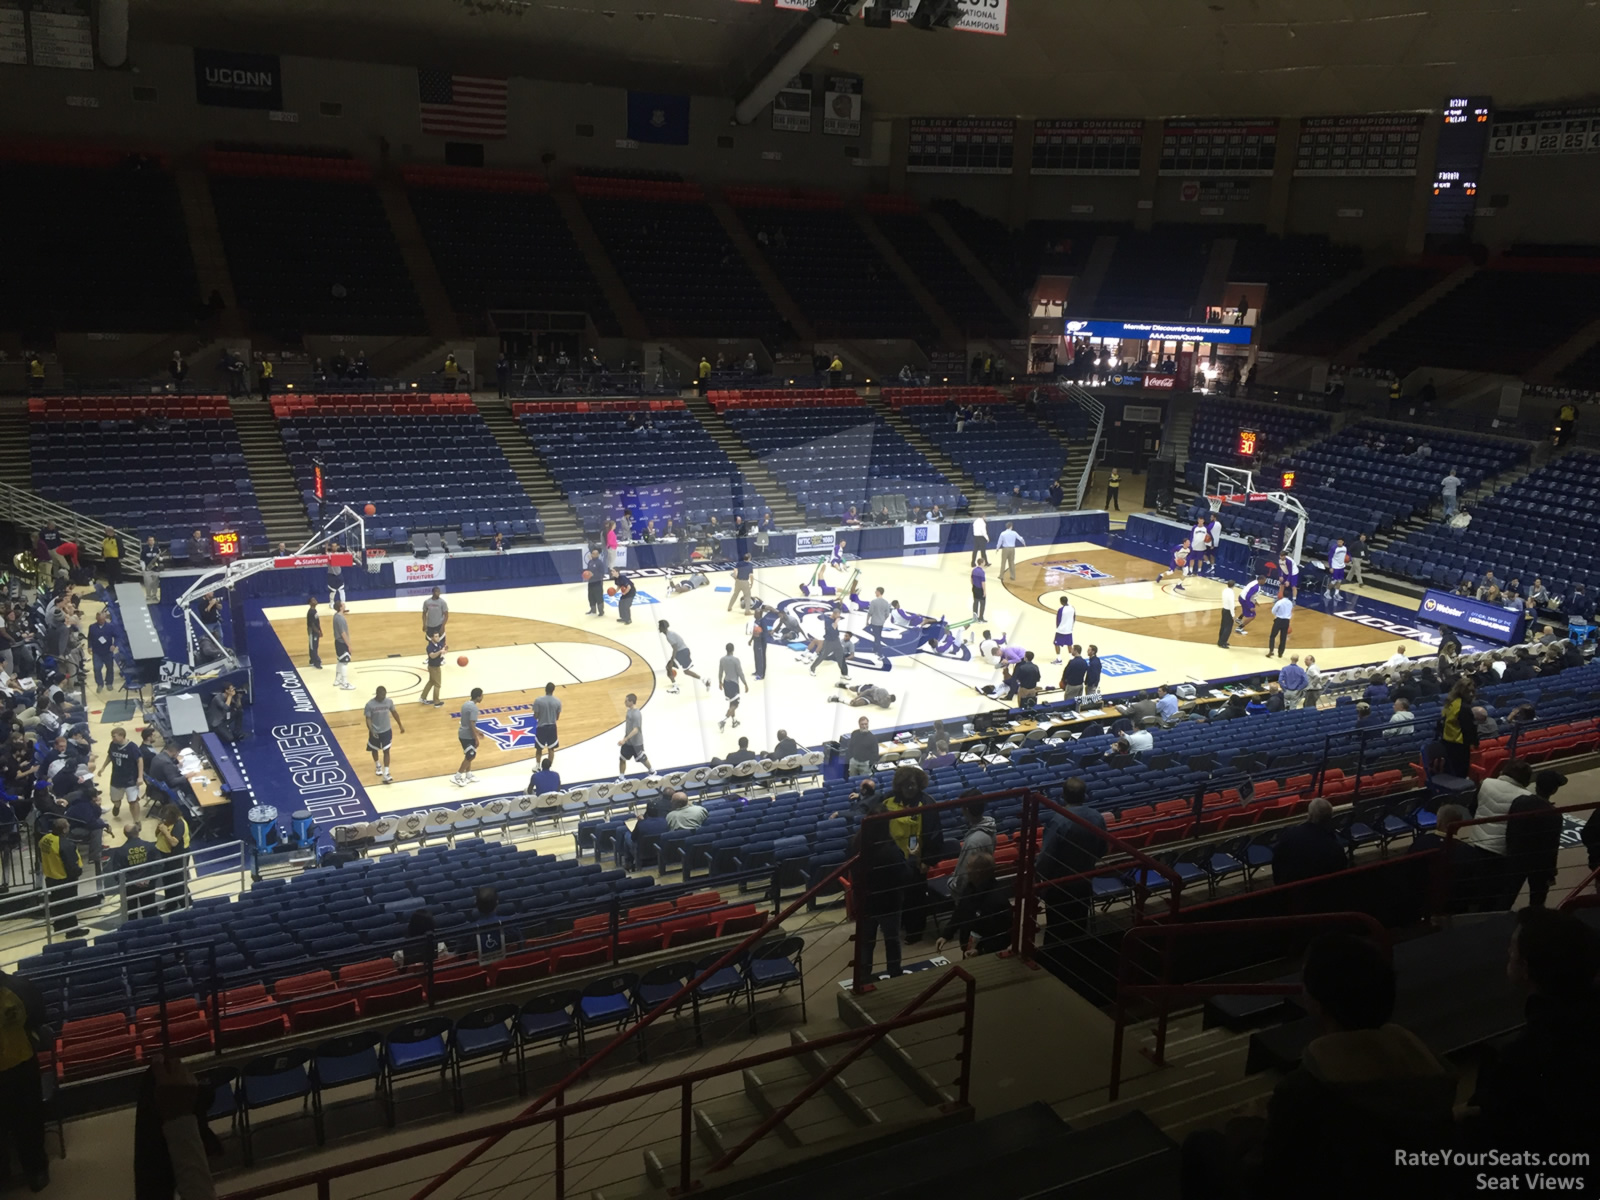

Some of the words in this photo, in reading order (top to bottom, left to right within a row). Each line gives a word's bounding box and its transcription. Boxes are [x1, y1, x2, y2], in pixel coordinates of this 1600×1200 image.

[205, 67, 272, 86] UCONN
[1083, 121, 1142, 129] CONFERENCE
[1338, 117, 1417, 126] CHAMPIONSHIP
[1495, 139, 1506, 150] C
[1521, 137, 1529, 149] 9
[1540, 136, 1558, 149] 22
[1565, 135, 1583, 148] 25
[1123, 323, 1151, 331] Member
[1149, 333, 1204, 341] AAA.com/Quote
[1241, 440, 1253, 454] 30
[212, 533, 238, 542] 40:55
[219, 543, 234, 554] 30
[406, 563, 434, 572] BOB'S
[602, 563, 715, 581] CONN
[1436, 603, 1465, 617] Webster
[275, 670, 302, 690] Court
[285, 689, 315, 713] Alumni
[271, 722, 367, 824] HUSKIES
[128, 845, 145, 855] CSC
